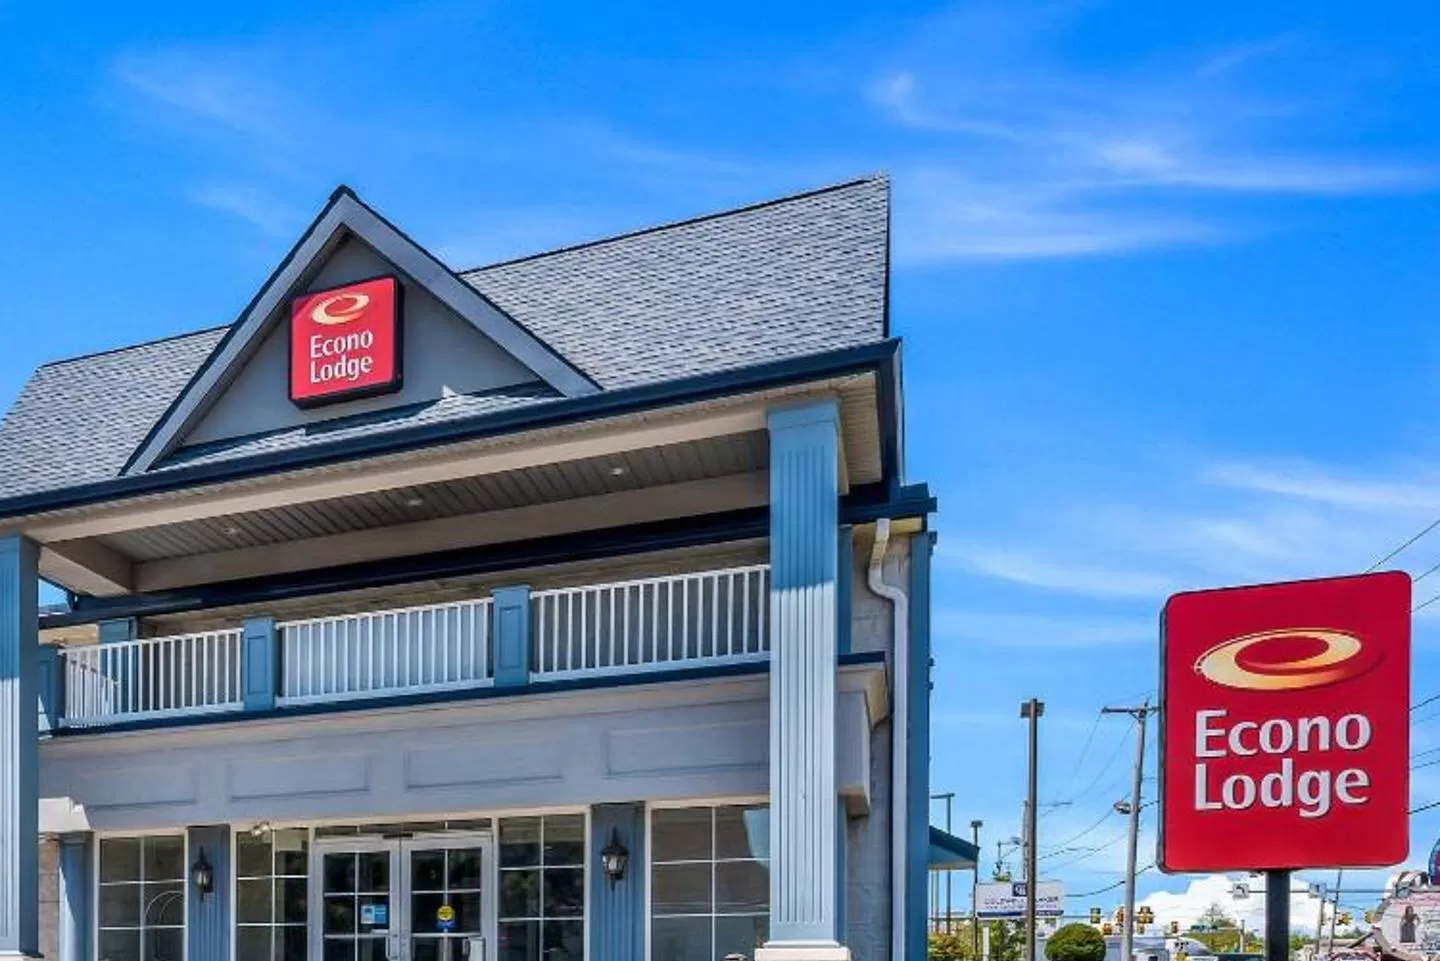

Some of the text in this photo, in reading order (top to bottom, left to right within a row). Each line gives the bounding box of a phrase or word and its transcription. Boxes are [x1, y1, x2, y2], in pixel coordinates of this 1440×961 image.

[310, 330, 374, 358] Econo
[310, 354, 374, 383] Lodge
[1195, 709, 1371, 757] Econo
[1195, 758, 1370, 818] Lodge
